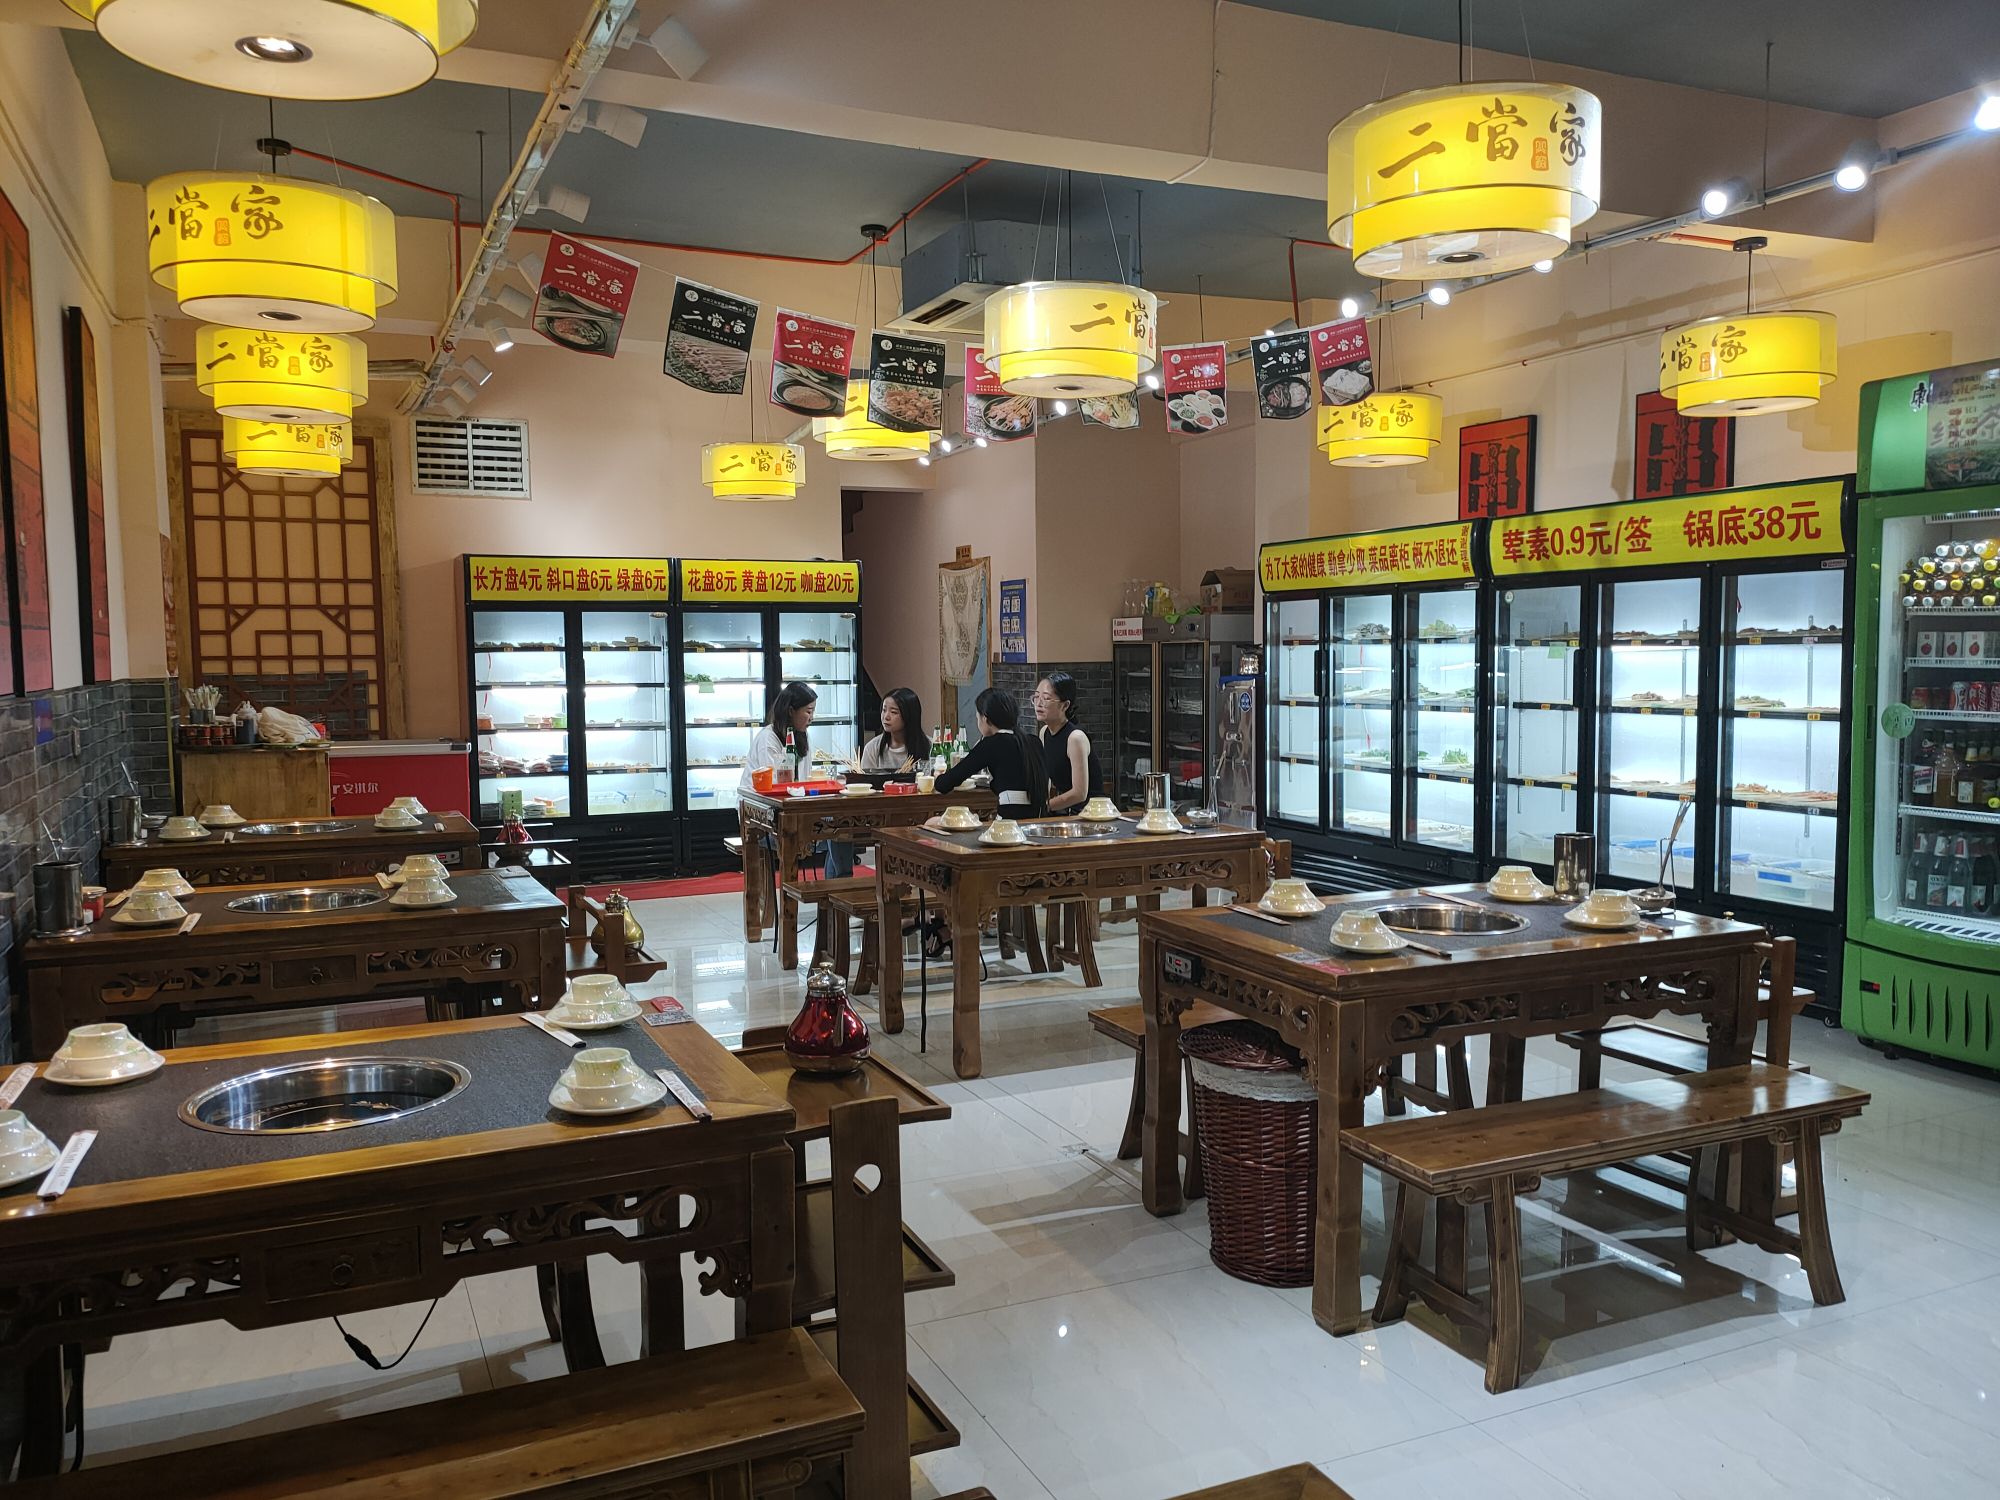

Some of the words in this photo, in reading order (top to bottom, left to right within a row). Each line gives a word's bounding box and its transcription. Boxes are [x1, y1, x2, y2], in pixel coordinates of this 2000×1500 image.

[1502, 516, 1652, 563] 荤素0.9元/签
[1683, 501, 1822, 549] 锅底38元
[1266, 551, 1326, 581] 为了大家的健康
[1328, 547, 1367, 576] 勤拿少取
[1368, 543, 1411, 573] 菜品离柜
[1412, 538, 1459, 569] 概不退还
[473, 566, 543, 592] 长方盘4元
[546, 567, 612, 592] 斜口盘6元
[617, 569, 667, 593] 绿盘6元
[688, 568, 737, 593] 花盘8元
[741, 569, 797, 594] 黄盘12元
[801, 570, 855, 594] 咖盘20元
